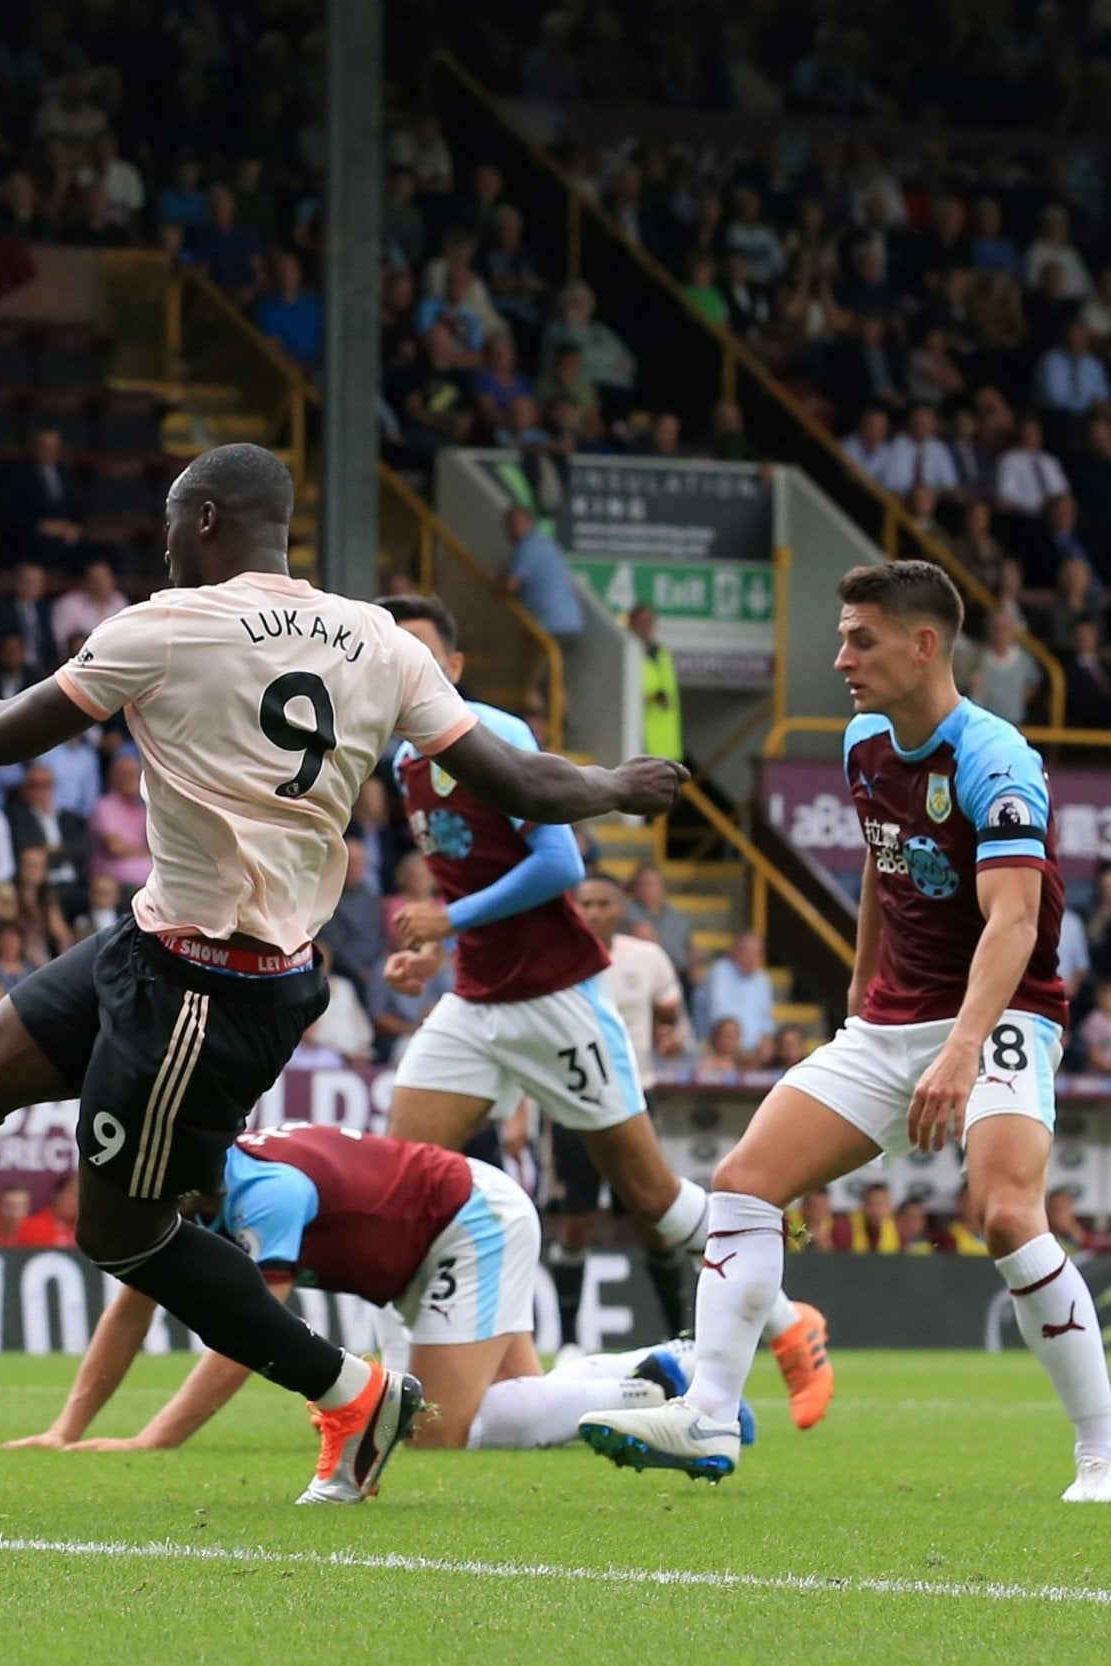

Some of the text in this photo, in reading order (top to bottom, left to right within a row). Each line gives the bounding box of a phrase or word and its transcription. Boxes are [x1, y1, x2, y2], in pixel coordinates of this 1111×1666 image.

[259, 671, 336, 798] 9
[179, 939, 229, 966] SNOW
[557, 1041, 609, 1092] 31
[979, 1024, 1029, 1077] 8
[88, 1111, 126, 1166] 9
[430, 1257, 458, 1301] 3
